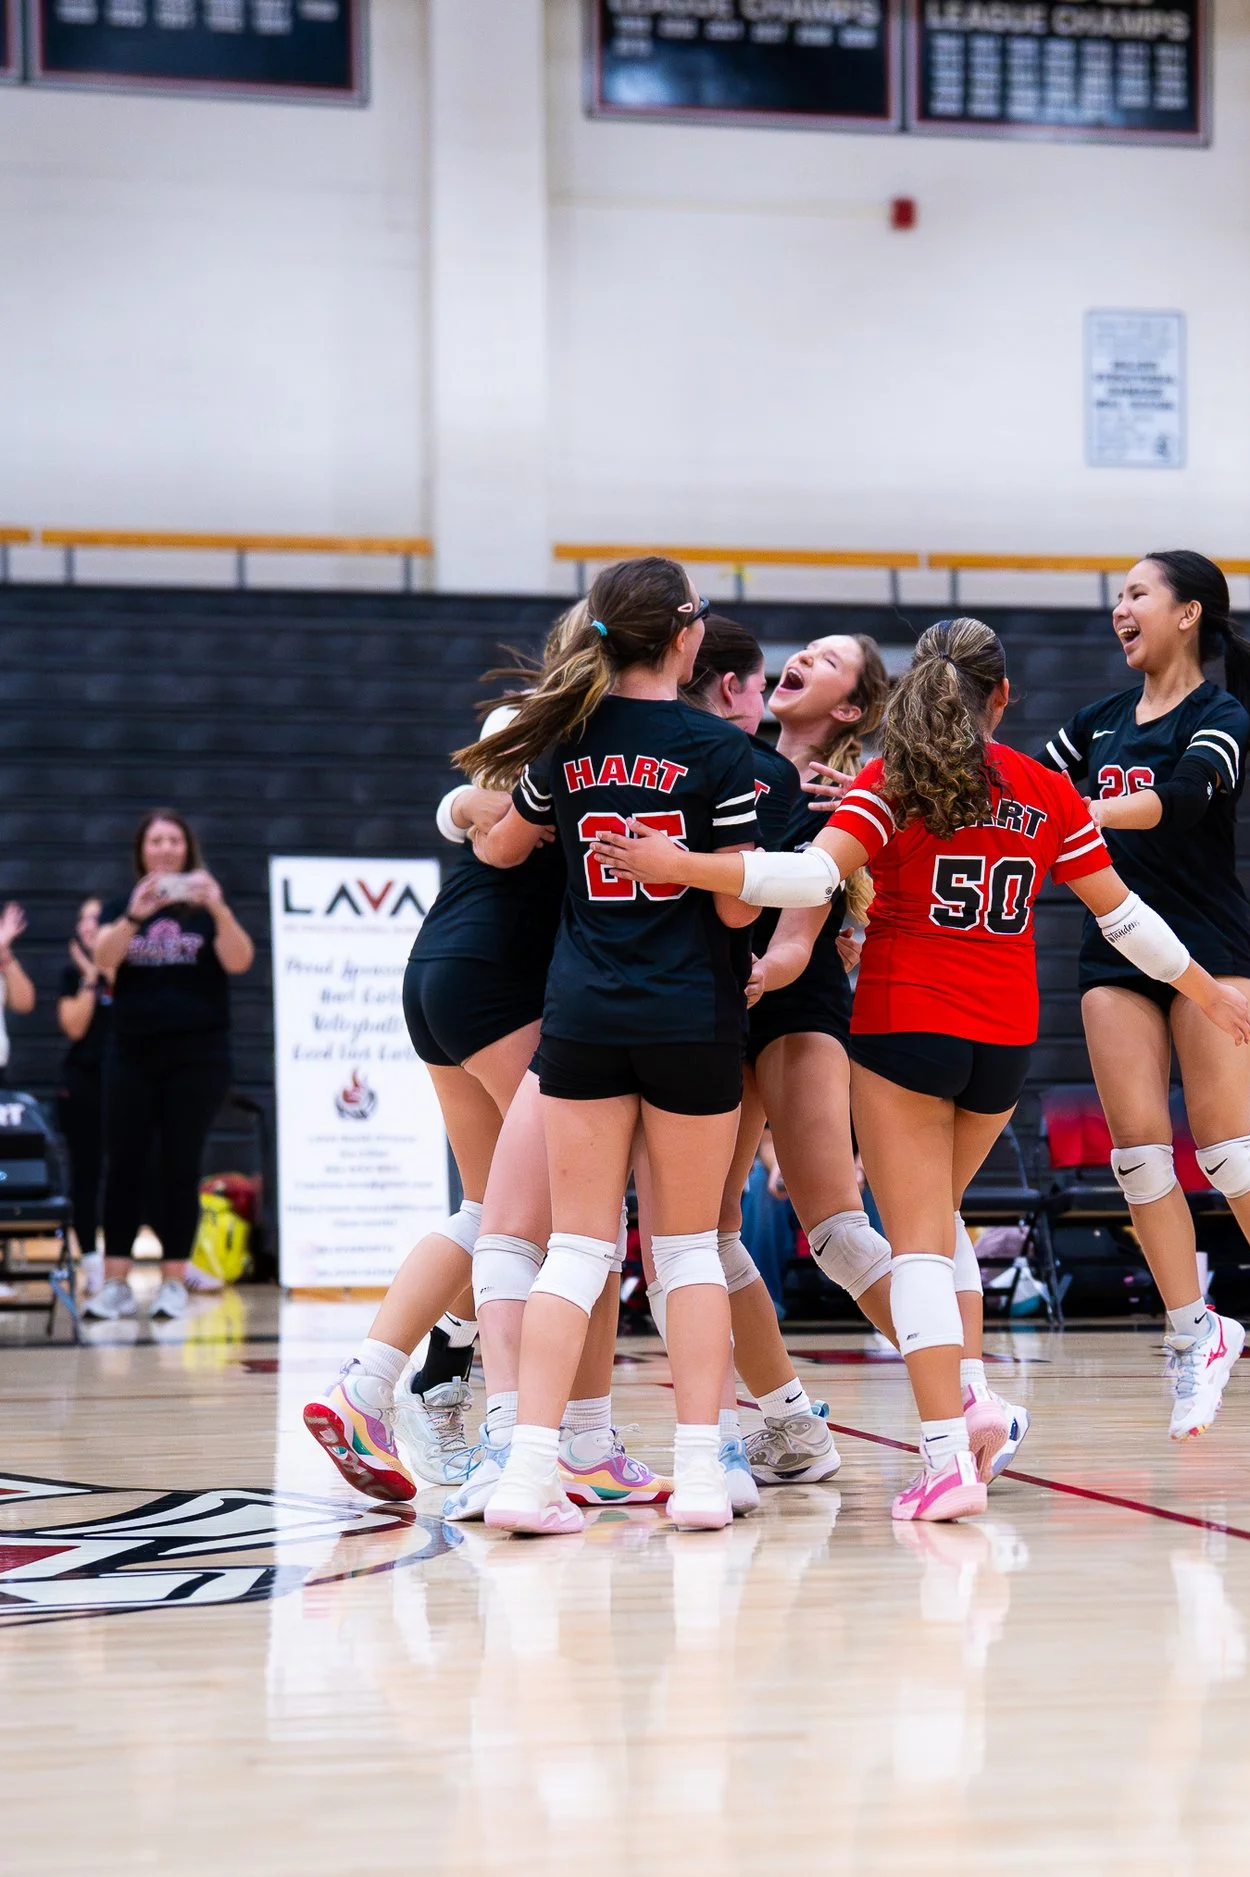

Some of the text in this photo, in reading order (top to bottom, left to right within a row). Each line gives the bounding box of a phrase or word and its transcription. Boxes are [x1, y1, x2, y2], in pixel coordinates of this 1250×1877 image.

[925, 2, 1190, 40] LEAGUE CHAMPS
[563, 755, 688, 794] HART
[282, 878, 427, 915] LAVA
[929, 854, 1036, 935] 50
